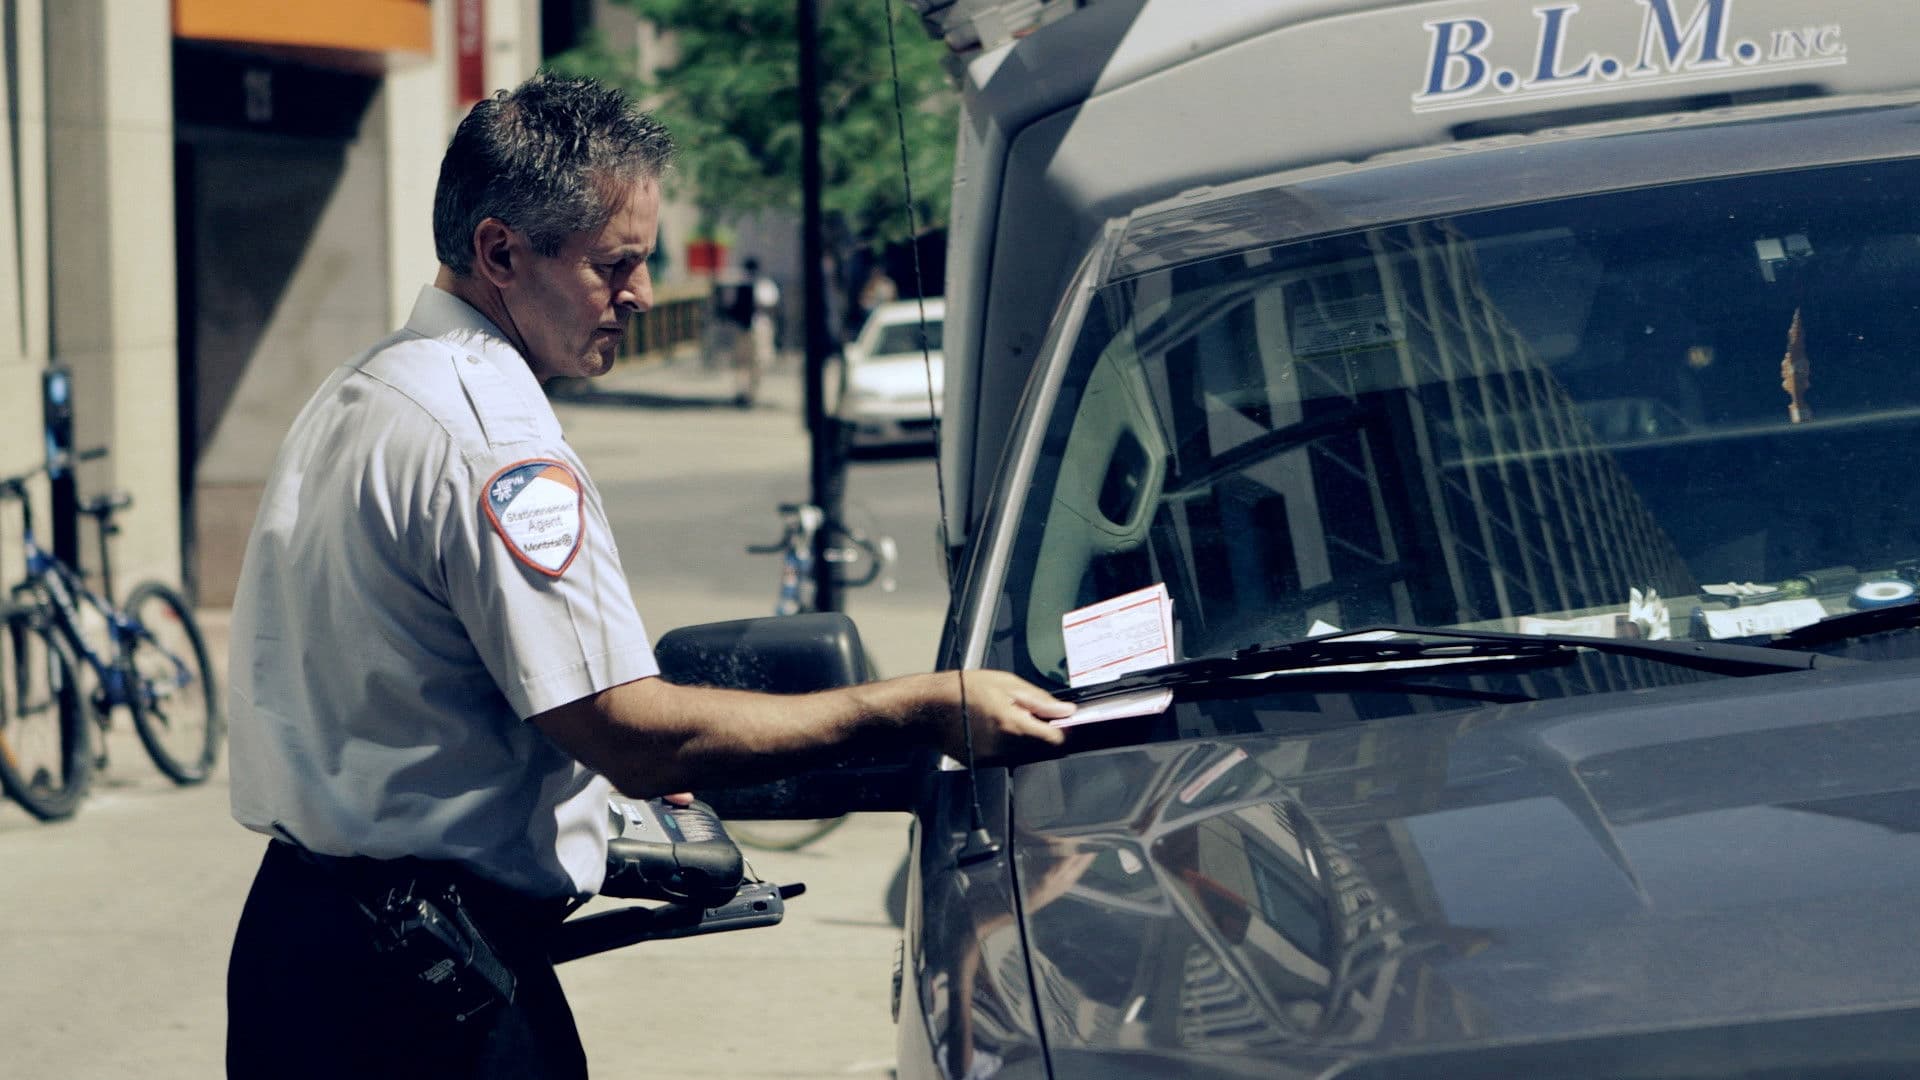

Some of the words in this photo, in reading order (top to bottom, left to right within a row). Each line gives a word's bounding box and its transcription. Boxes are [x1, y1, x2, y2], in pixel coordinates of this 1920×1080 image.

[1412, 0, 1760, 98] B.L.M.
[1768, 25, 1847, 61] INC.
[528, 515, 563, 534] Agent
